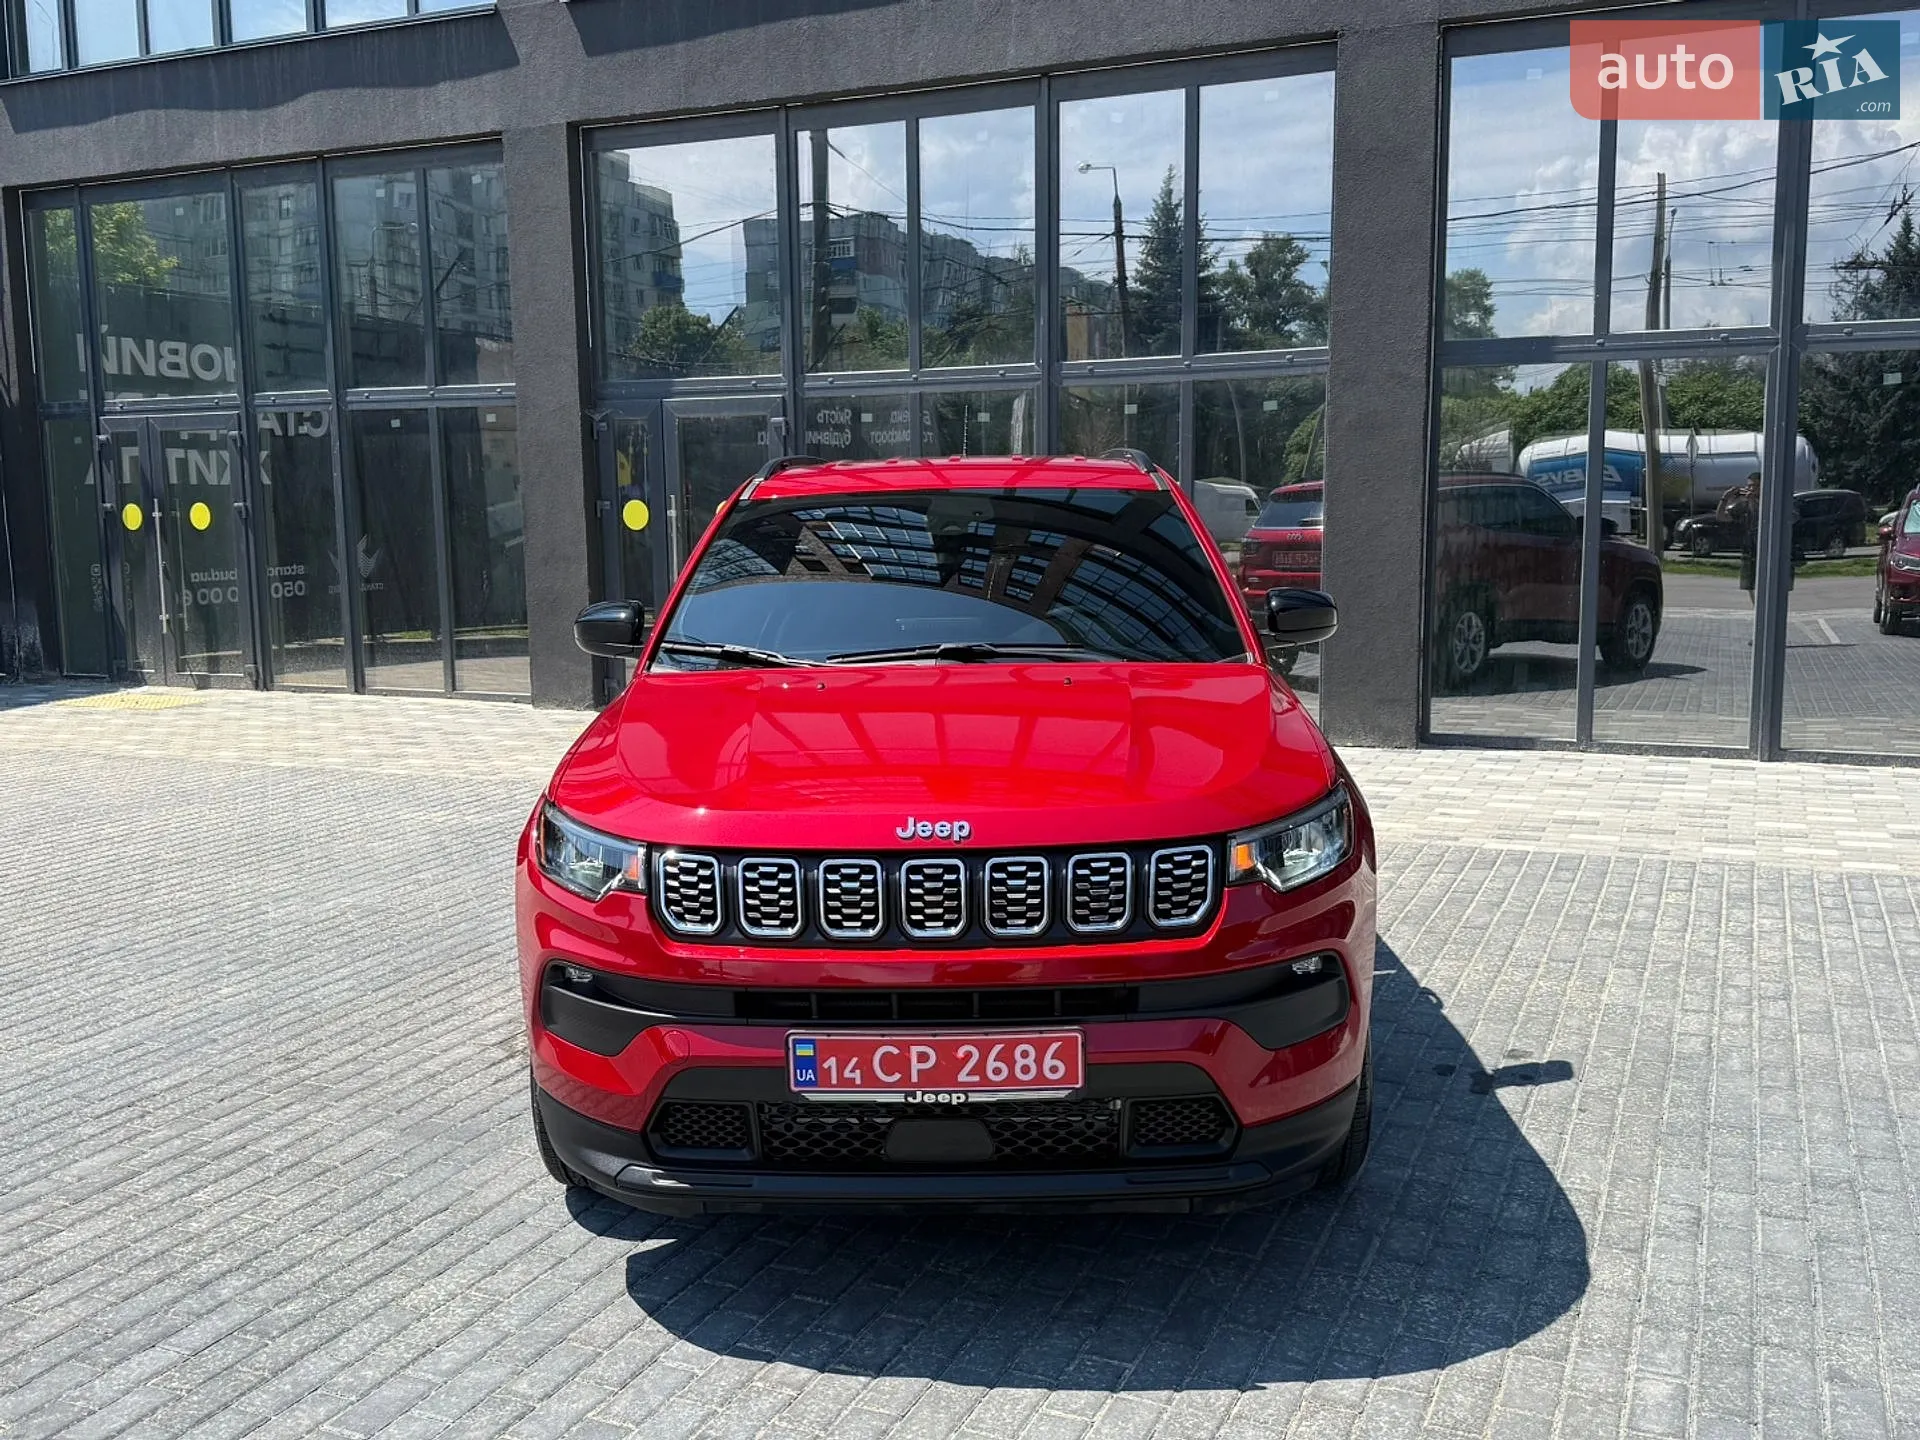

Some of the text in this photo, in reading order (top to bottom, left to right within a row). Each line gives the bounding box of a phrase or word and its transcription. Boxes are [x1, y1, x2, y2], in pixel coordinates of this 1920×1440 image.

[896, 816, 971, 841] Jeep
[822, 1056, 861, 1085] 14
[957, 1041, 1066, 1082] 2686
[796, 1069, 816, 1081] UA
[907, 1090, 967, 1105] Jeep
